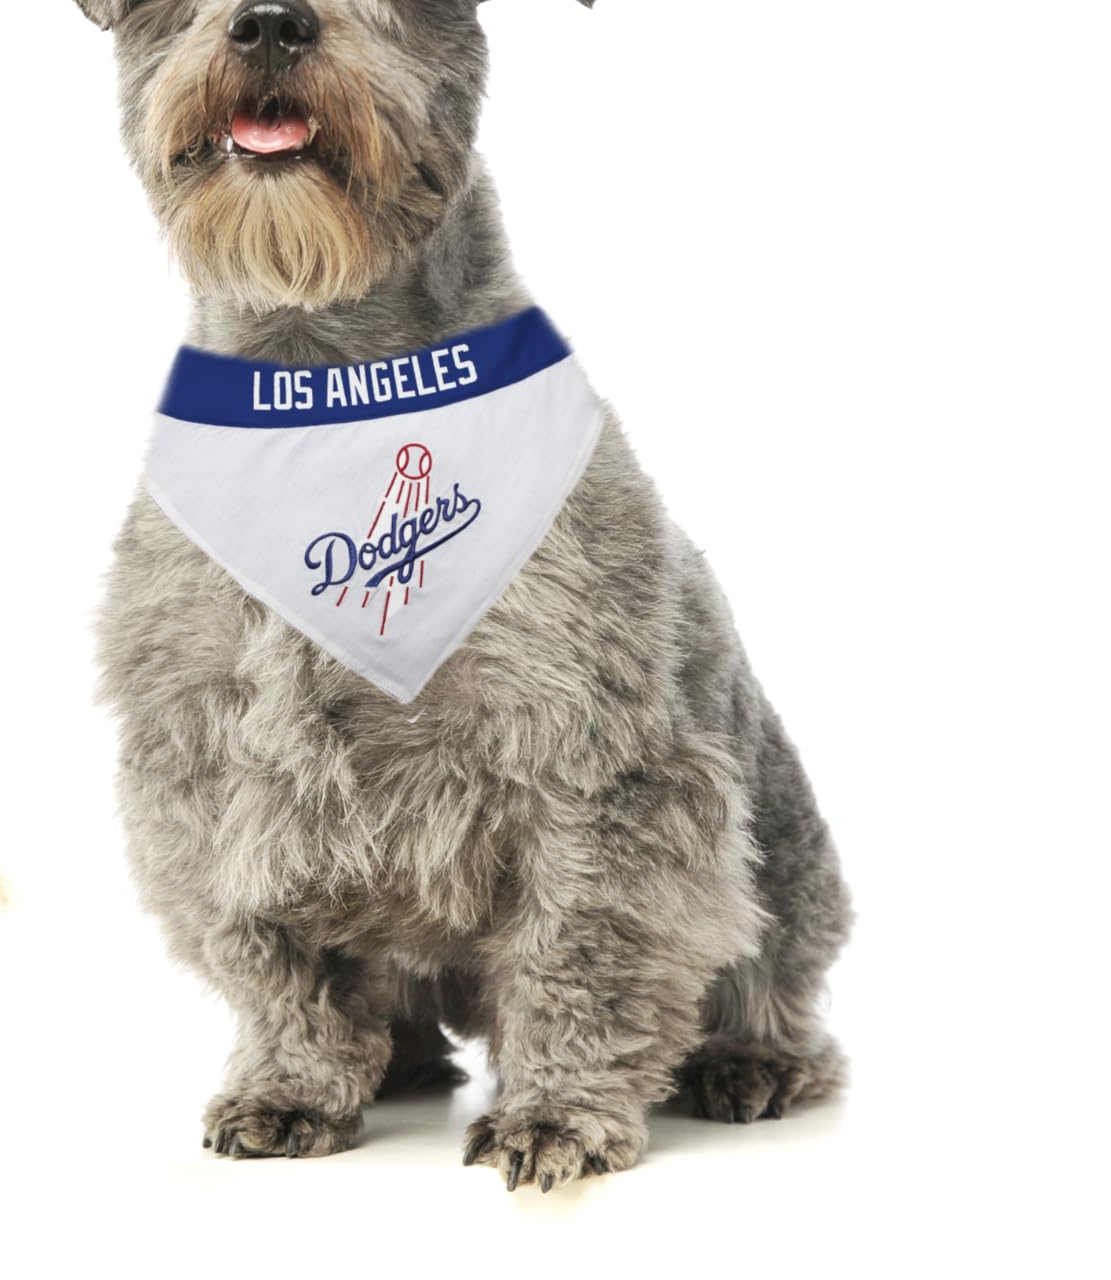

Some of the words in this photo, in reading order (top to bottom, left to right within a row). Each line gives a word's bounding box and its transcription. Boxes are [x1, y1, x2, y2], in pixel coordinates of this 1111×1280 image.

[252, 370, 314, 411] LOS
[326, 343, 478, 408] ANGELES
[304, 483, 481, 596] Dodgers
